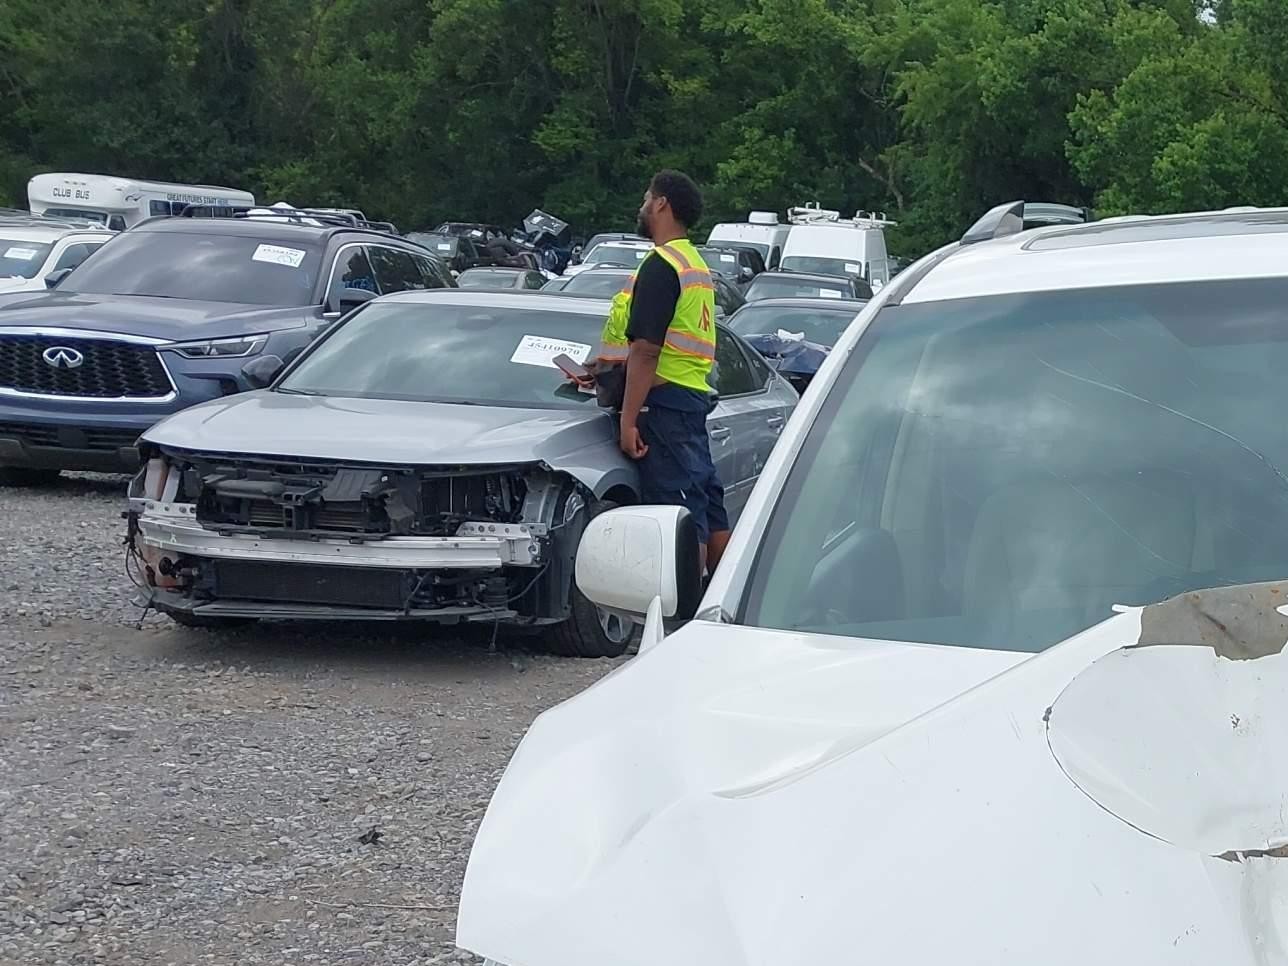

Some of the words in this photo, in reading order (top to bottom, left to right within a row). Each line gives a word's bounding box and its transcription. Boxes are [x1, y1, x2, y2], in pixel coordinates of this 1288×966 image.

[53, 187, 71, 198] CLUB
[75, 189, 90, 200] BUS
[167, 194, 182, 202] GREAT
[182, 194, 203, 204] FUTURES
[204, 196, 217, 205] START
